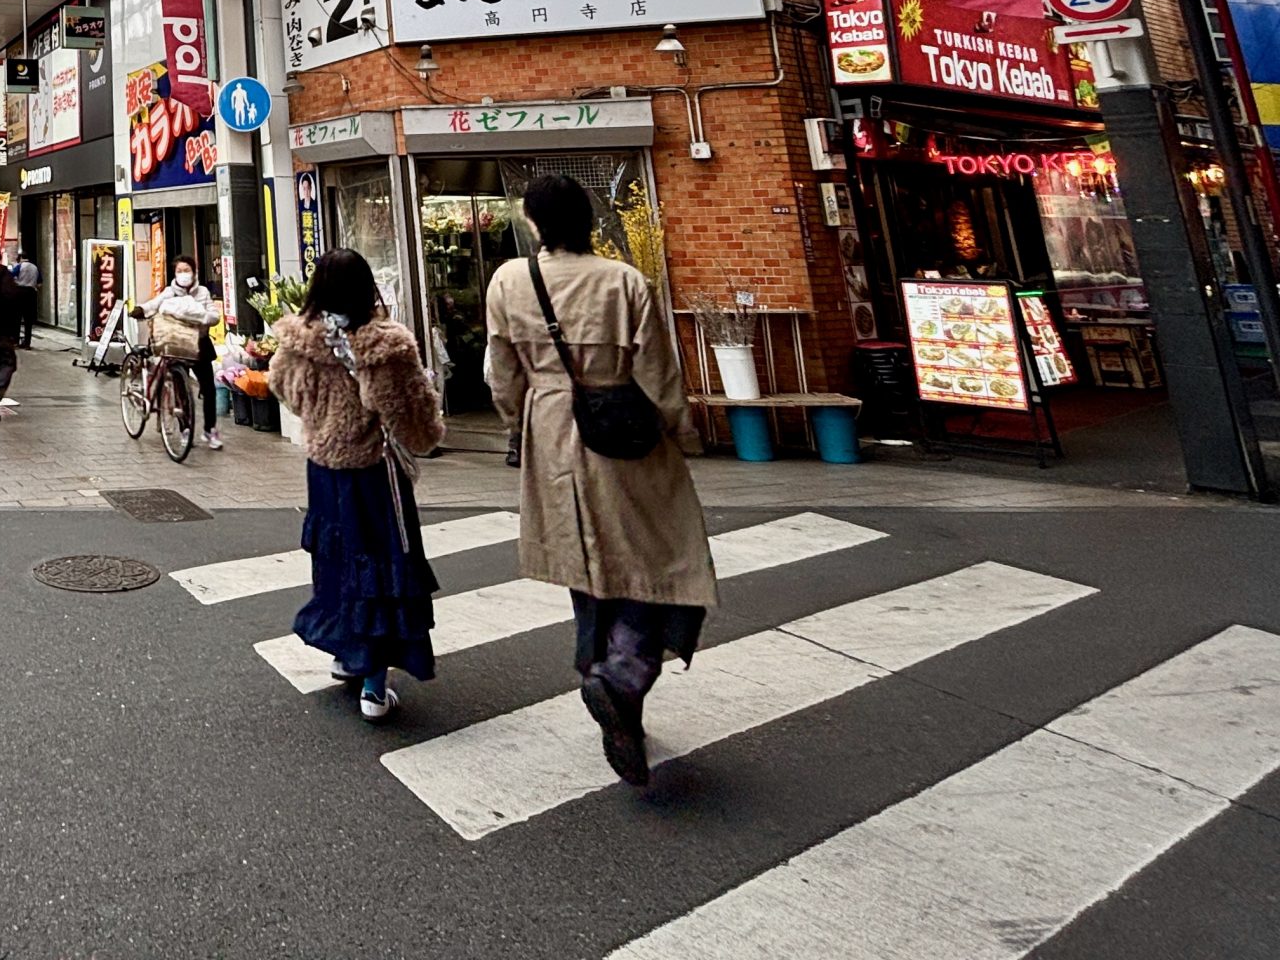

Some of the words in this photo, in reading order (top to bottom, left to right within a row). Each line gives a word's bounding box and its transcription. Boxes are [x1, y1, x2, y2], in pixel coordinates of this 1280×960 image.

[484, 0, 647, 26] 高円寺店
[827, 7, 884, 29] Tokyo
[75, 21, 104, 33] カラオケ
[830, 27, 885, 44] Kebab
[162, 17, 210, 84] pal
[934, 29, 994, 55] TURKISH
[997, 41, 1038, 63] KEBAB
[88, 75, 107, 90] PRONTO
[921, 44, 994, 91] Tokyo
[996, 58, 1055, 100] Kebab
[446, 110, 471, 133] 花
[475, 104, 600, 132] ゼフィール
[294, 128, 304, 147] 花
[306, 117, 360, 145] ゼフィール
[941, 154, 1035, 175] TOKYO
[918, 285, 952, 295] Tokyo
[951, 286, 987, 296] Kebab
